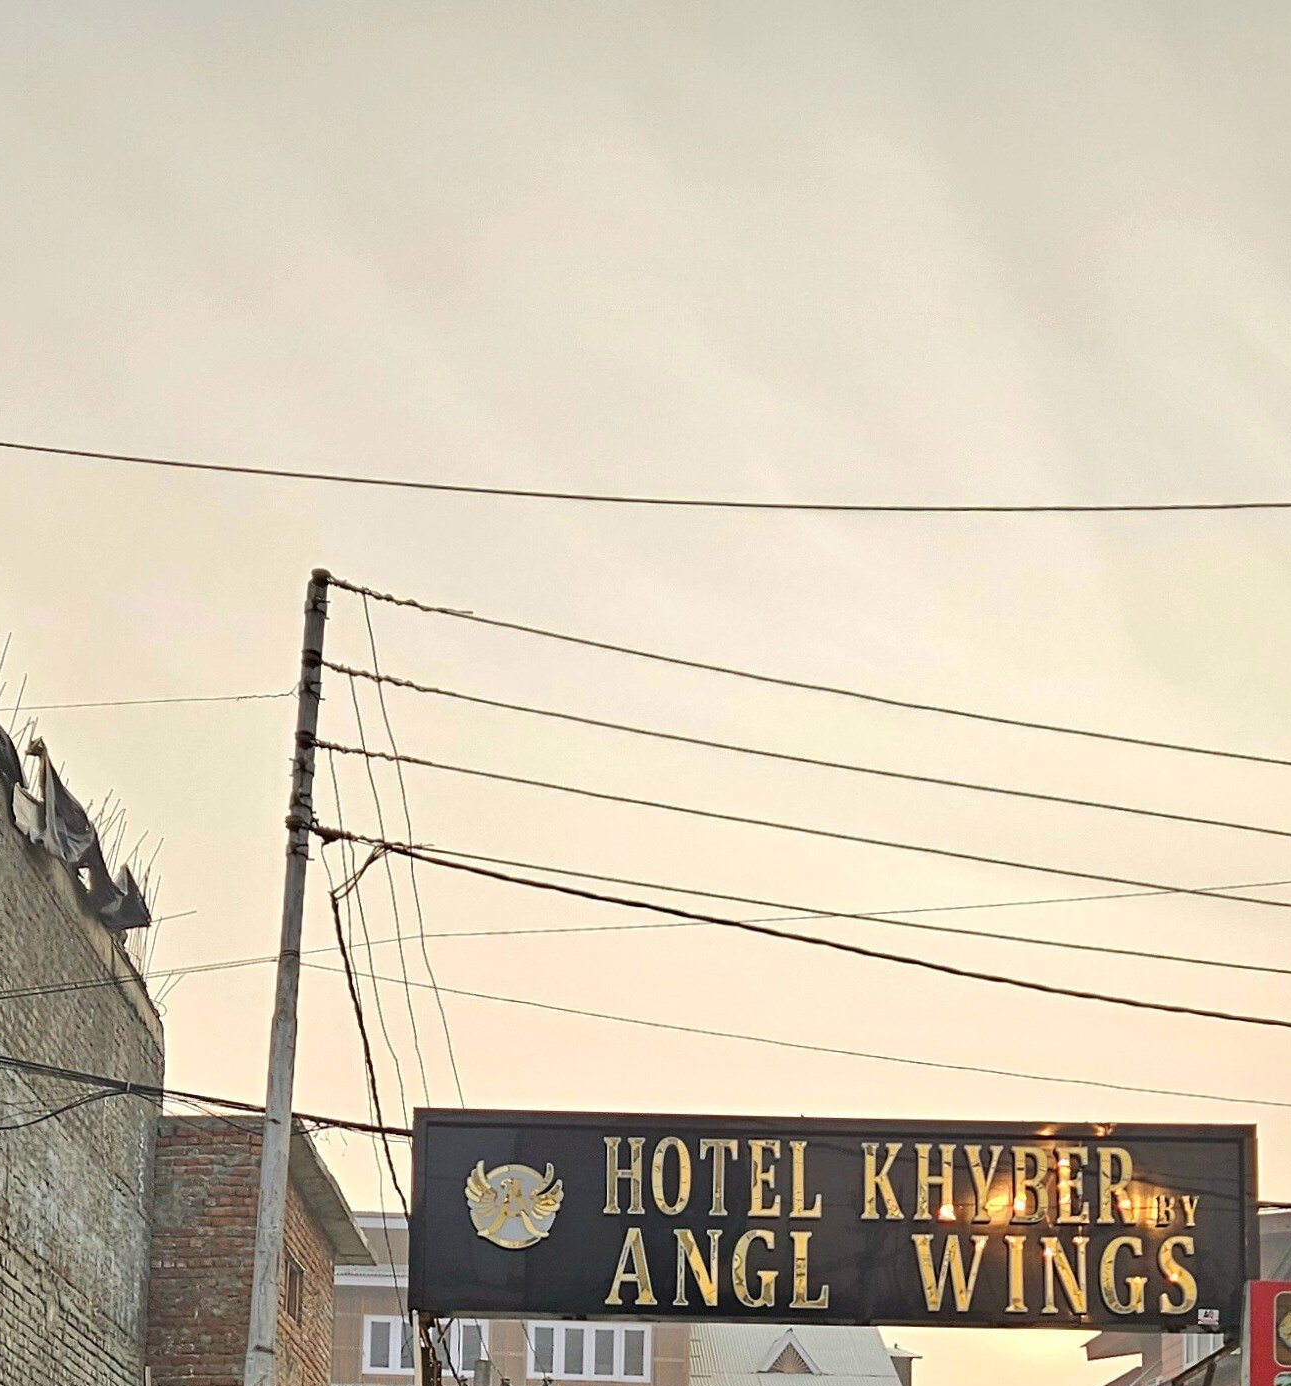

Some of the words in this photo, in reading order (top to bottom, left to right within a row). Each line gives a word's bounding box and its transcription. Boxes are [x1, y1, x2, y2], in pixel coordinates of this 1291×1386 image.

[603, 1136, 822, 1220] HOTEL
[860, 1140, 1139, 1226] KHYBER
[1155, 1195, 1200, 1227] BY
[605, 1227, 829, 1309] ANGL
[910, 1232, 1198, 1316] WINGS
